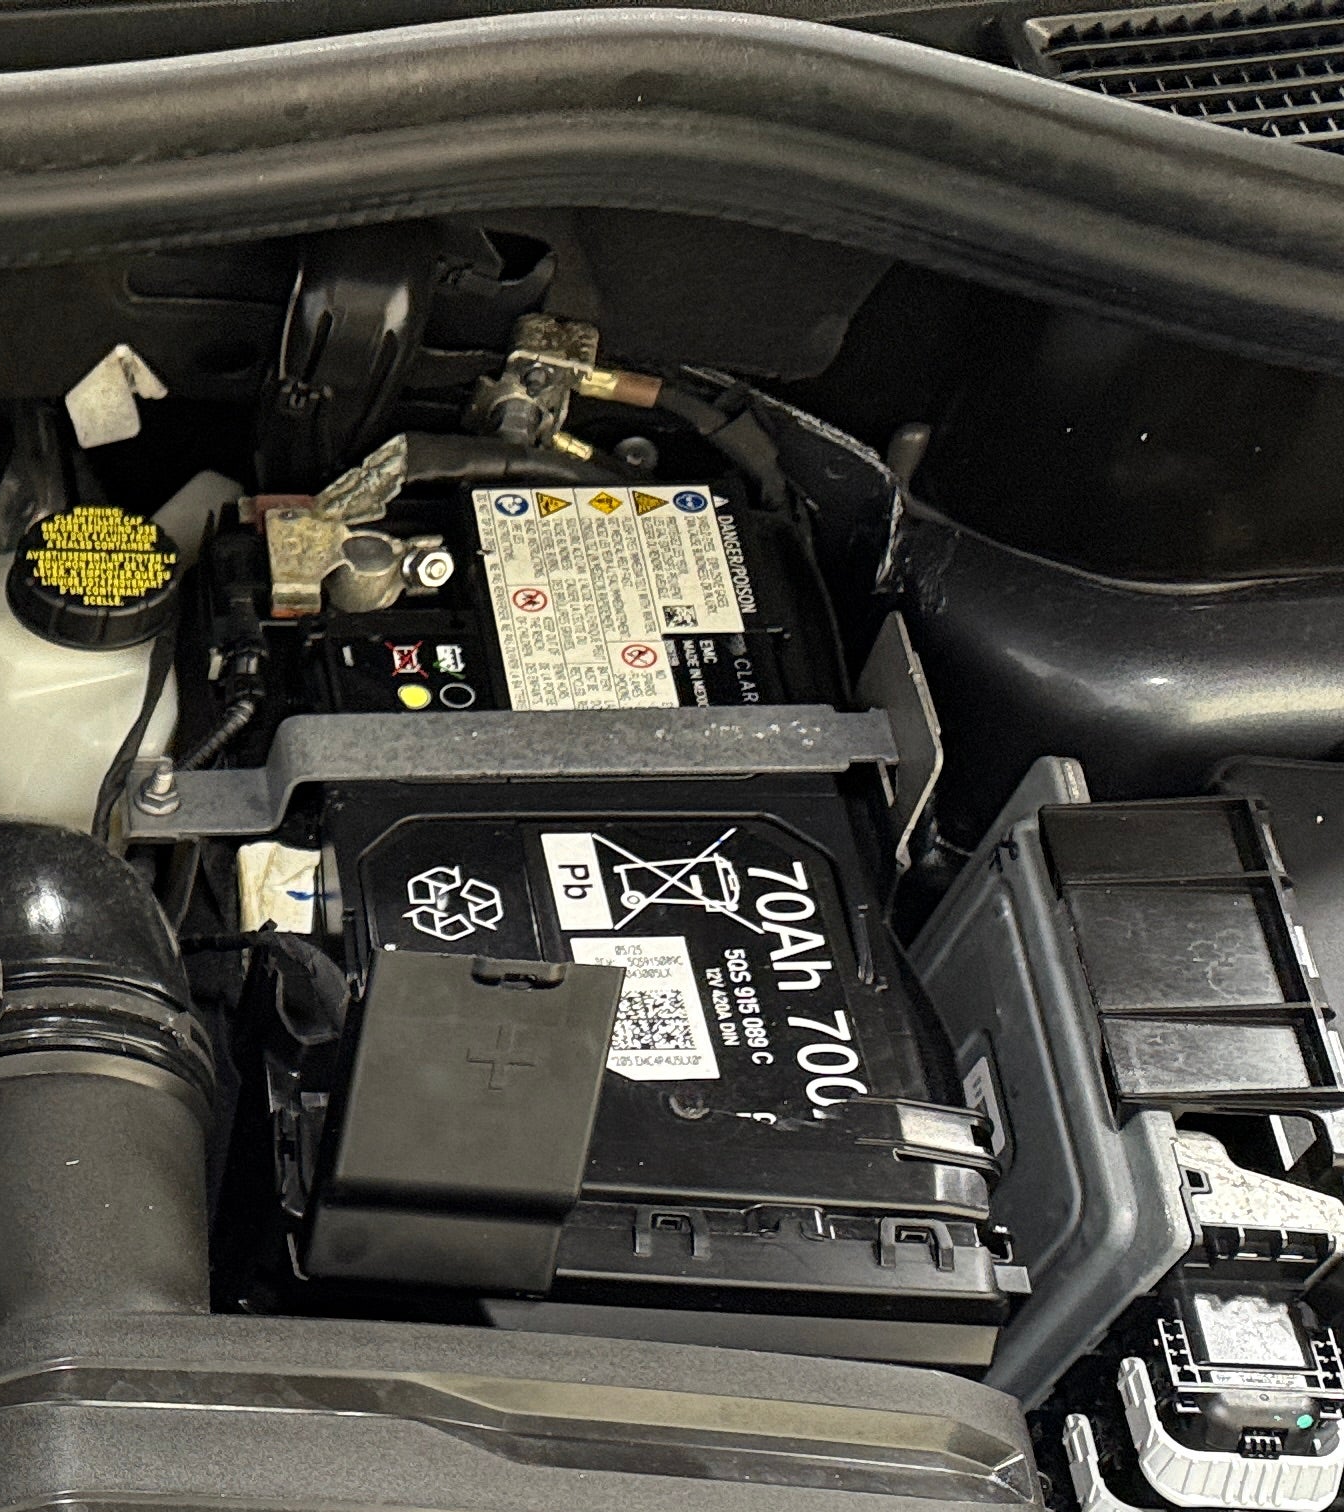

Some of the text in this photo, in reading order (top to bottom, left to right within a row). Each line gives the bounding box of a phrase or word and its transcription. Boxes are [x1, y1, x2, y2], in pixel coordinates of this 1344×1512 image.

[717, 515, 756, 614] DANGER/POISON
[733, 658, 759, 703] CLAR
[558, 864, 594, 899] Pb
[747, 861, 832, 991] 70Ah
[719, 1022, 740, 1046] DIN
[724, 949, 774, 1065] 5QS 915 089 C
